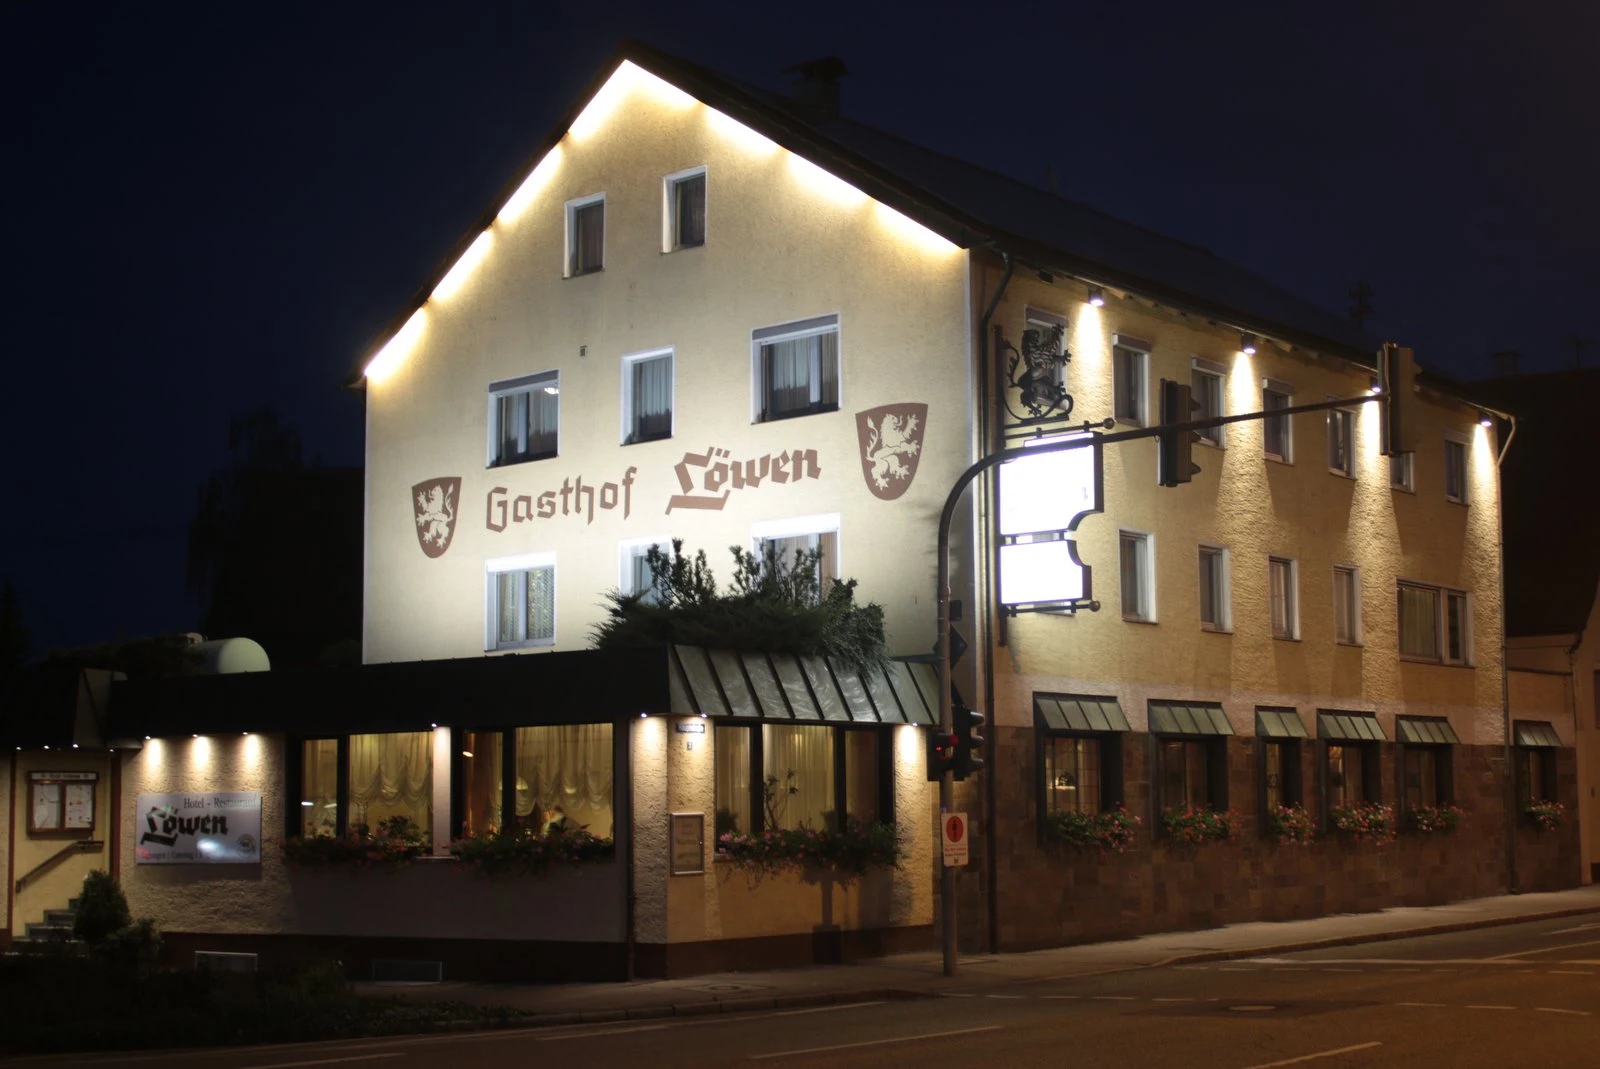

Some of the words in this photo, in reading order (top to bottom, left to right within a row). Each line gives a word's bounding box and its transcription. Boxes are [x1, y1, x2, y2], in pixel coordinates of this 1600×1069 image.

[485, 466, 638, 533] Gasthof
[666, 446, 822, 516] Löwen
[183, 797, 204, 809] Hotel
[140, 804, 229, 847] Löwen
